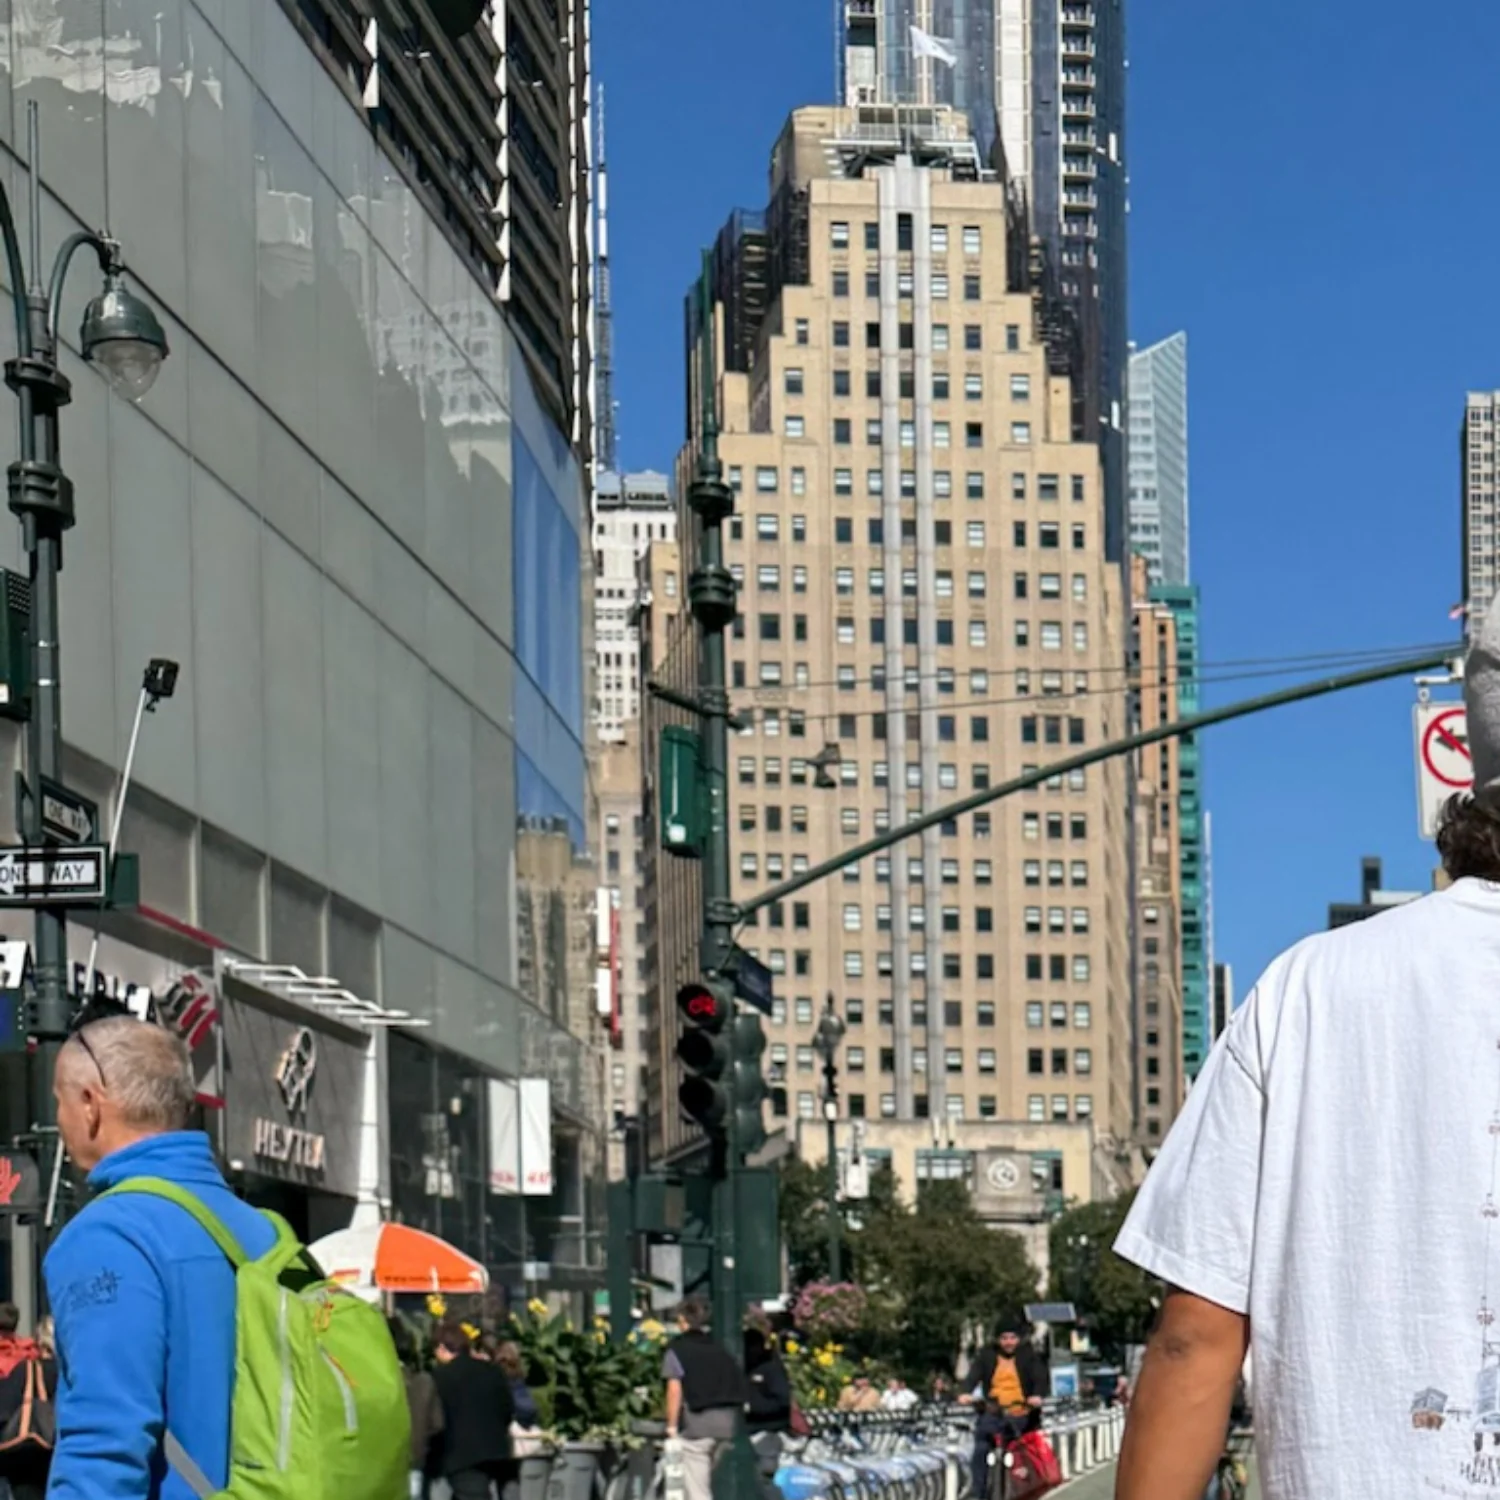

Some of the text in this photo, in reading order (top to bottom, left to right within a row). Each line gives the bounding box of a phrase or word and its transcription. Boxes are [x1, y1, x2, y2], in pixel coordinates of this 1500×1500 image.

[0, 864, 84, 884] ON WAY
[252, 1117, 326, 1170] HEYTEA
